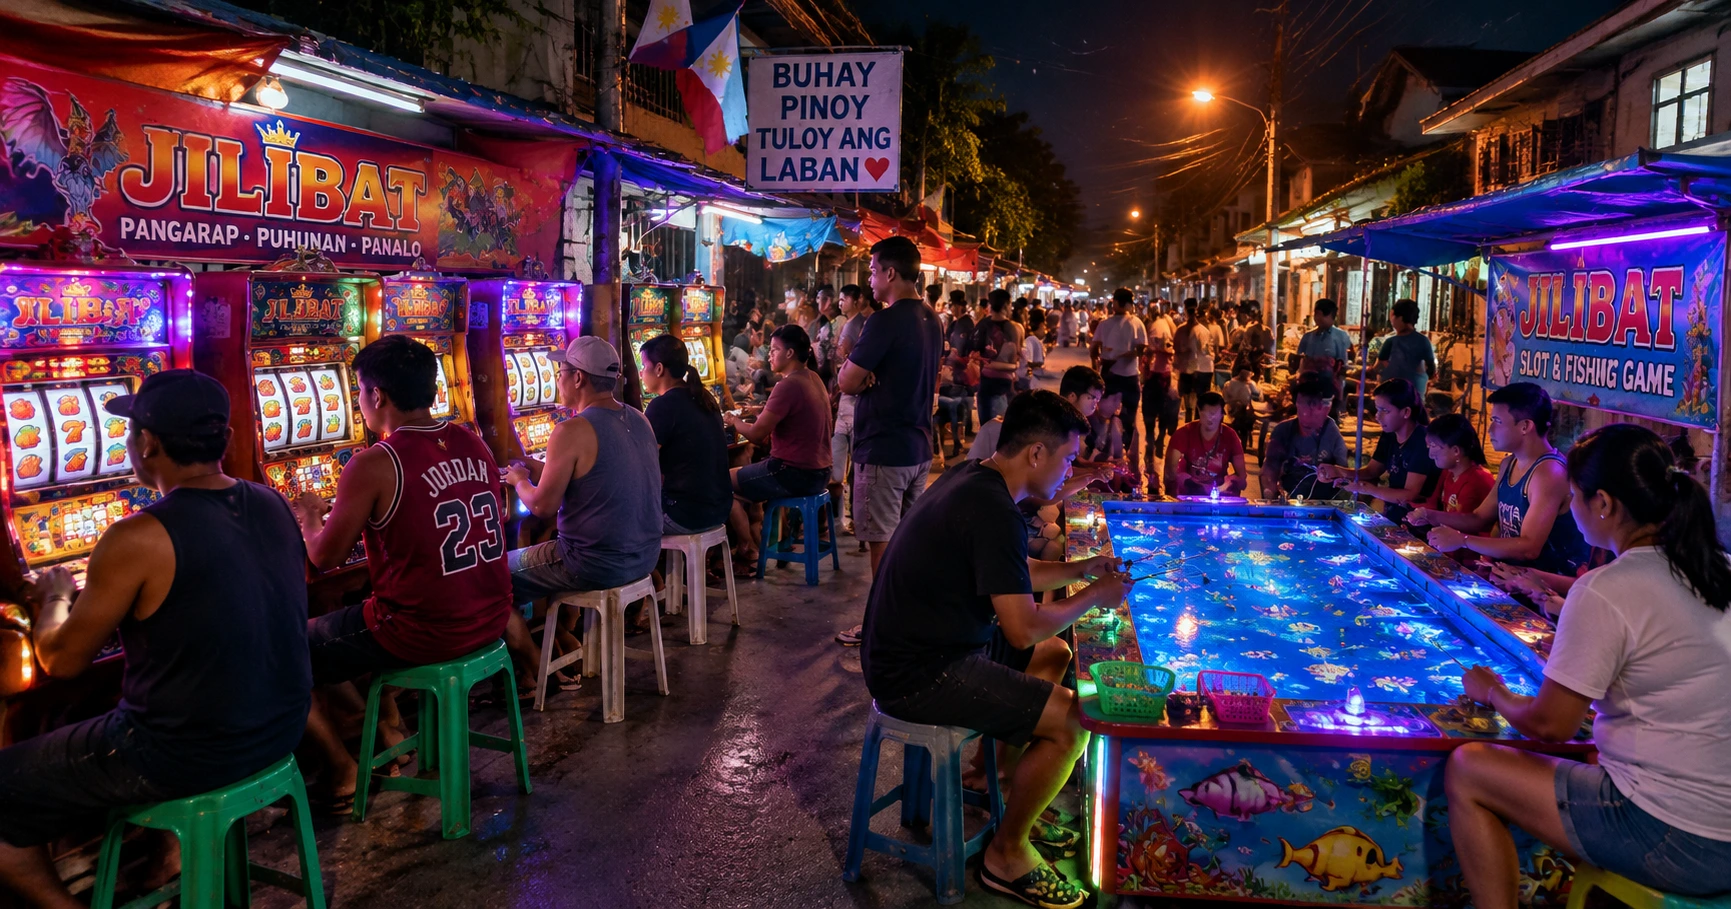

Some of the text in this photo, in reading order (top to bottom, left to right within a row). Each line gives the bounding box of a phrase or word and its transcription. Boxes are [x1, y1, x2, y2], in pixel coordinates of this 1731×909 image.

[773, 61, 876, 88] BUHAY
[781, 94, 870, 120] PINOY
[756, 126, 891, 150] TULOY ANG
[121, 125, 428, 233] JILIBAT
[761, 157, 859, 182] LABAN
[120, 217, 421, 258] PANGARAP PUHUNAN PANALO
[1519, 265, 1685, 350] JILIBAT
[1519, 350, 1550, 379] SLOT
[1552, 353, 1561, 381] &
[1622, 360, 1675, 397] GAME
[421, 457, 489, 498] JORDAN
[434, 490, 504, 576] 23
